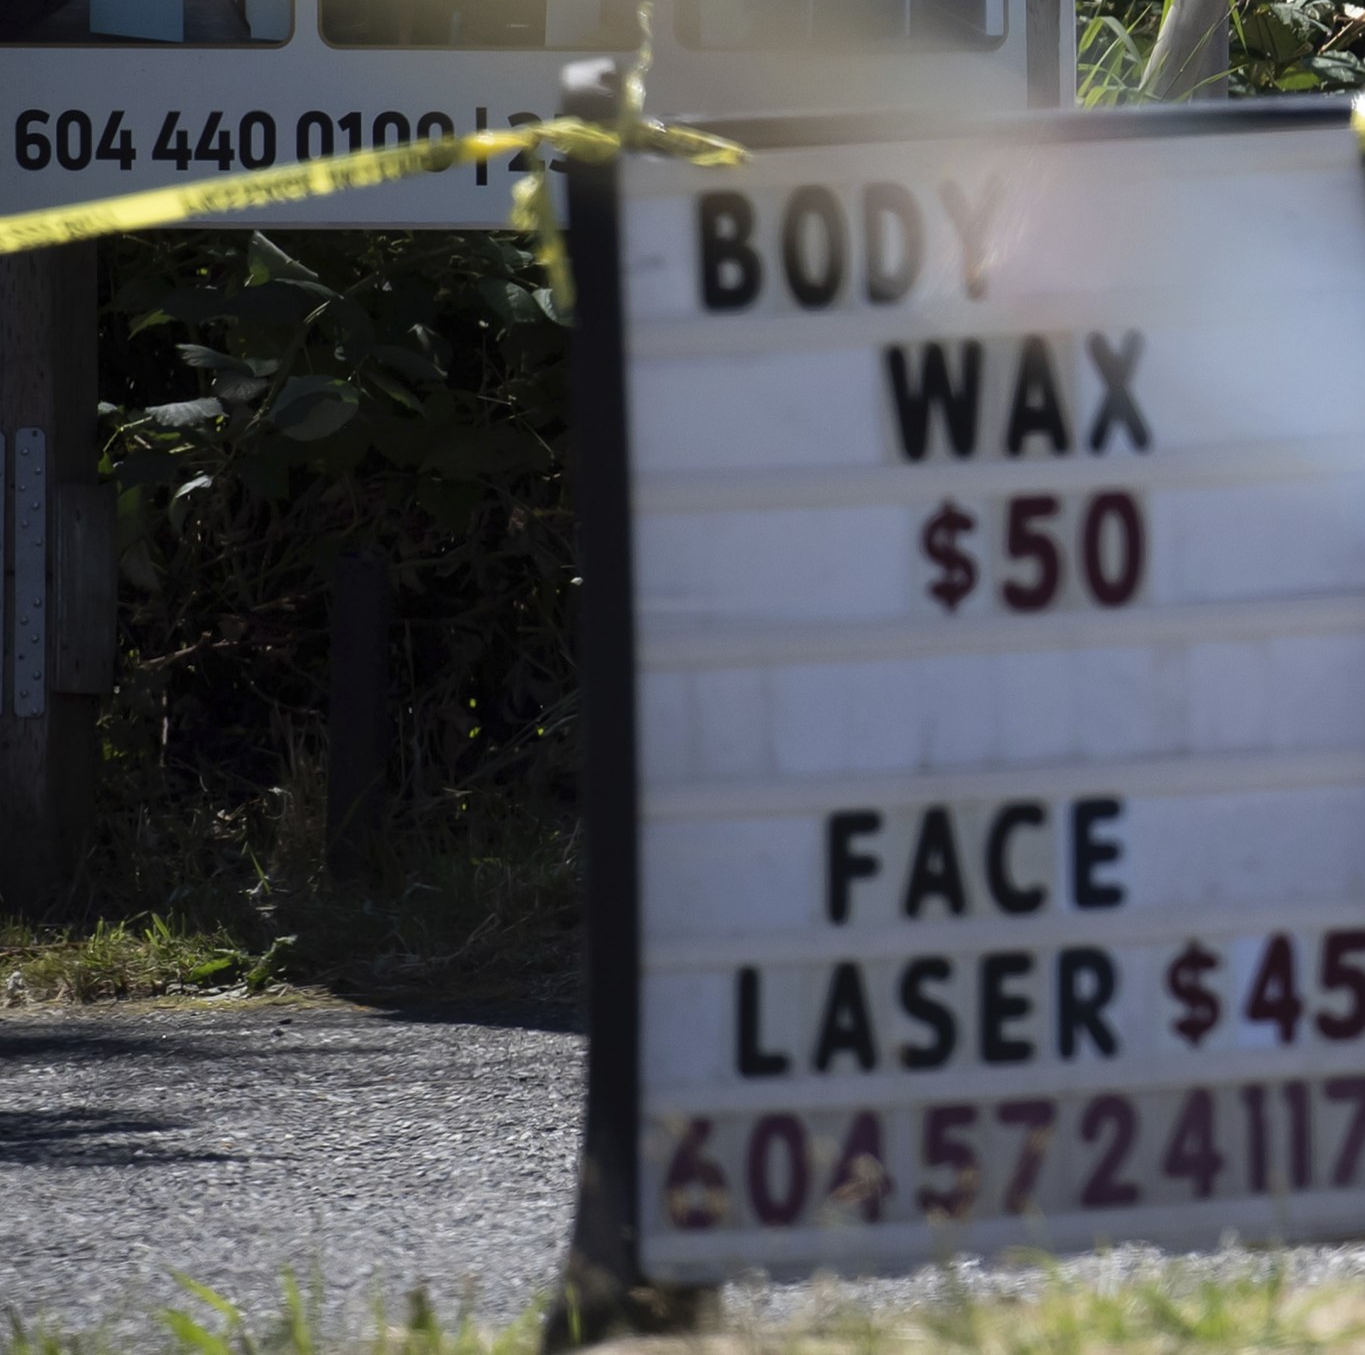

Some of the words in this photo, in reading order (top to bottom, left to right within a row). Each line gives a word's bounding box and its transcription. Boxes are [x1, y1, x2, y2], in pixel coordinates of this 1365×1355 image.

[15, 109, 136, 172] 604
[152, 109, 276, 172] 440
[697, 179, 1002, 312] BODY
[883, 331, 1152, 463] WAX
[921, 491, 1147, 614] $50
[824, 795, 1130, 925] FACE
[734, 946, 1119, 1078] LASER
